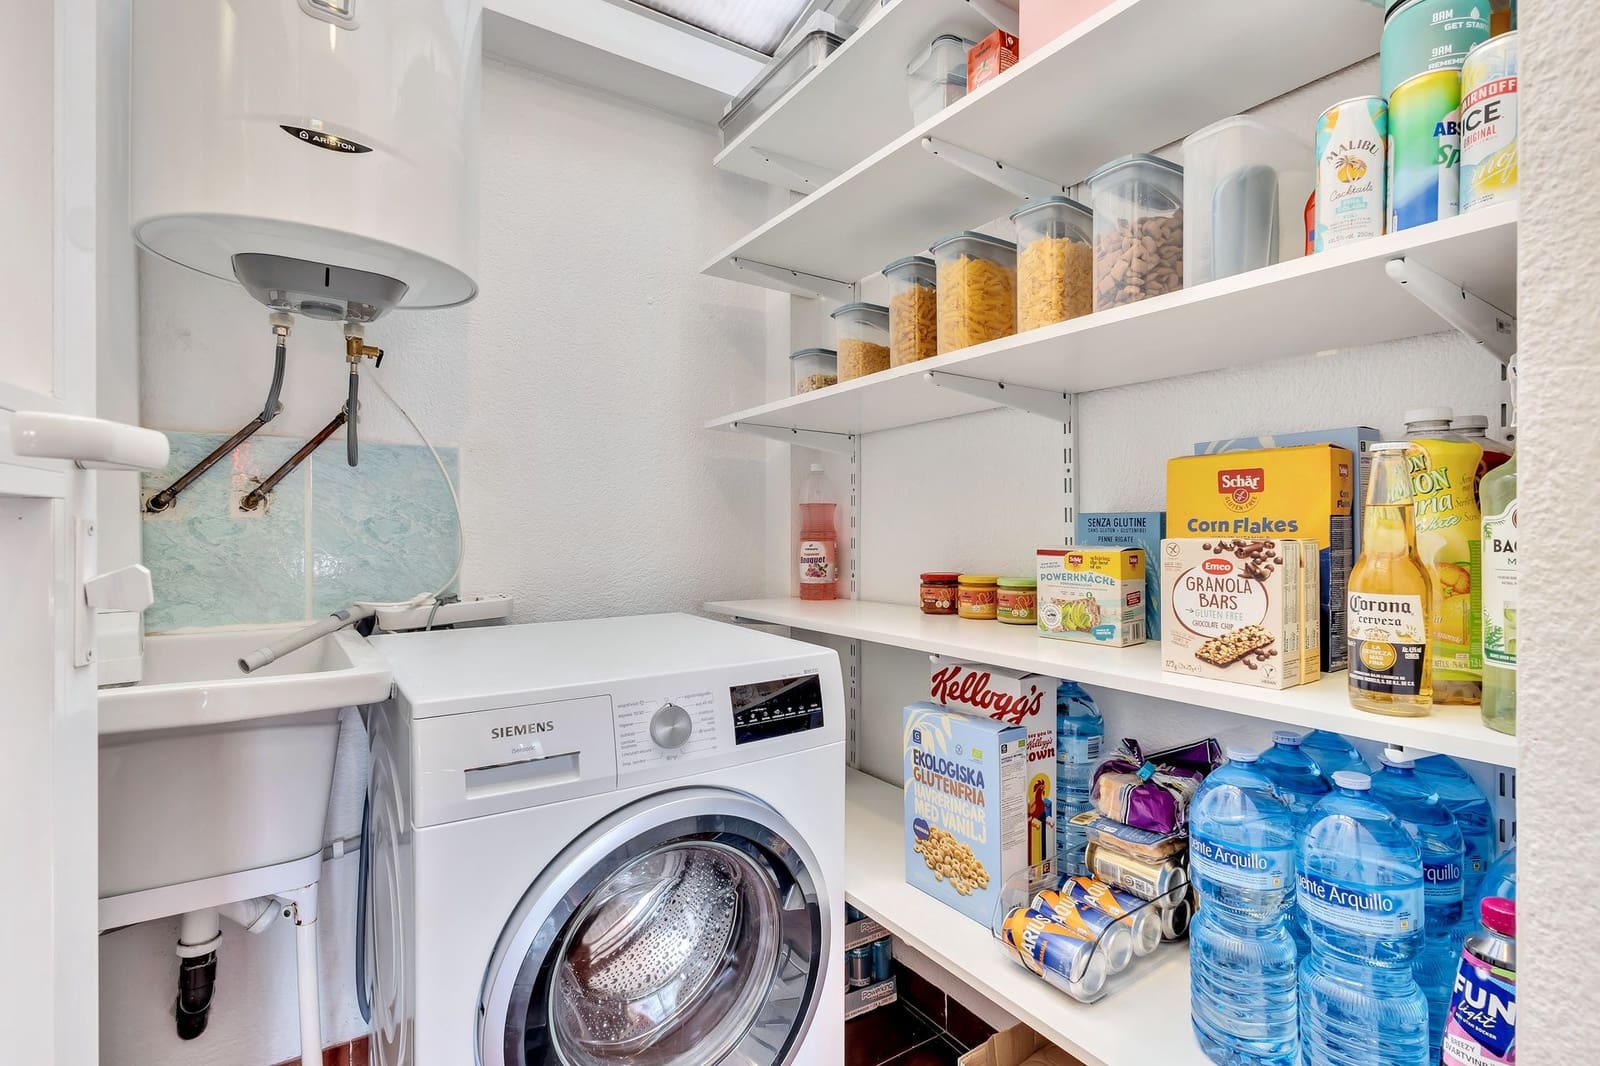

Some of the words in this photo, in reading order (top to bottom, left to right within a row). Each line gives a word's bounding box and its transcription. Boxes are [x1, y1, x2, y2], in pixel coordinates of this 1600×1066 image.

[1432, 9, 1453, 22] 8AM
[1444, 22, 1464, 31] GET
[1431, 44, 1453, 57] 9AM
[1462, 100, 1501, 137] ICE
[312, 135, 356, 152] ARISTON
[1326, 139, 1380, 164] MALIBU
[1222, 474, 1260, 489] Schär
[1088, 517, 1111, 527] SENZA
[1113, 517, 1147, 527] GLUTINE
[1187, 518, 1230, 533] Corn
[1233, 517, 1299, 534] Flakes
[1205, 562, 1231, 571] Emco
[1186, 576, 1253, 595] GRANOLA
[1199, 593, 1238, 610] BARS
[1350, 595, 1412, 614] Corona
[1195, 608, 1223, 620] GLUTEN
[1225, 611, 1244, 622] FREE
[1358, 615, 1402, 627] cerveza
[1192, 620, 1219, 630] CHOCOLATE
[1220, 621, 1234, 630] CHIP
[931, 666, 1044, 726] Kellogg's
[491, 720, 554, 739] SIEMENS
[1026, 747, 1055, 762] own
[913, 749, 985, 789] EKOLOGISKA
[913, 766, 985, 808] GLUTENFRIA
[914, 800, 939, 823] MED
[941, 808, 988, 845] VANILJ
[1214, 846, 1268, 870] Arquillo
[1329, 887, 1393, 912] Arquillo
[1454, 973, 1517, 1028] FUN
[1458, 999, 1497, 1029] light
